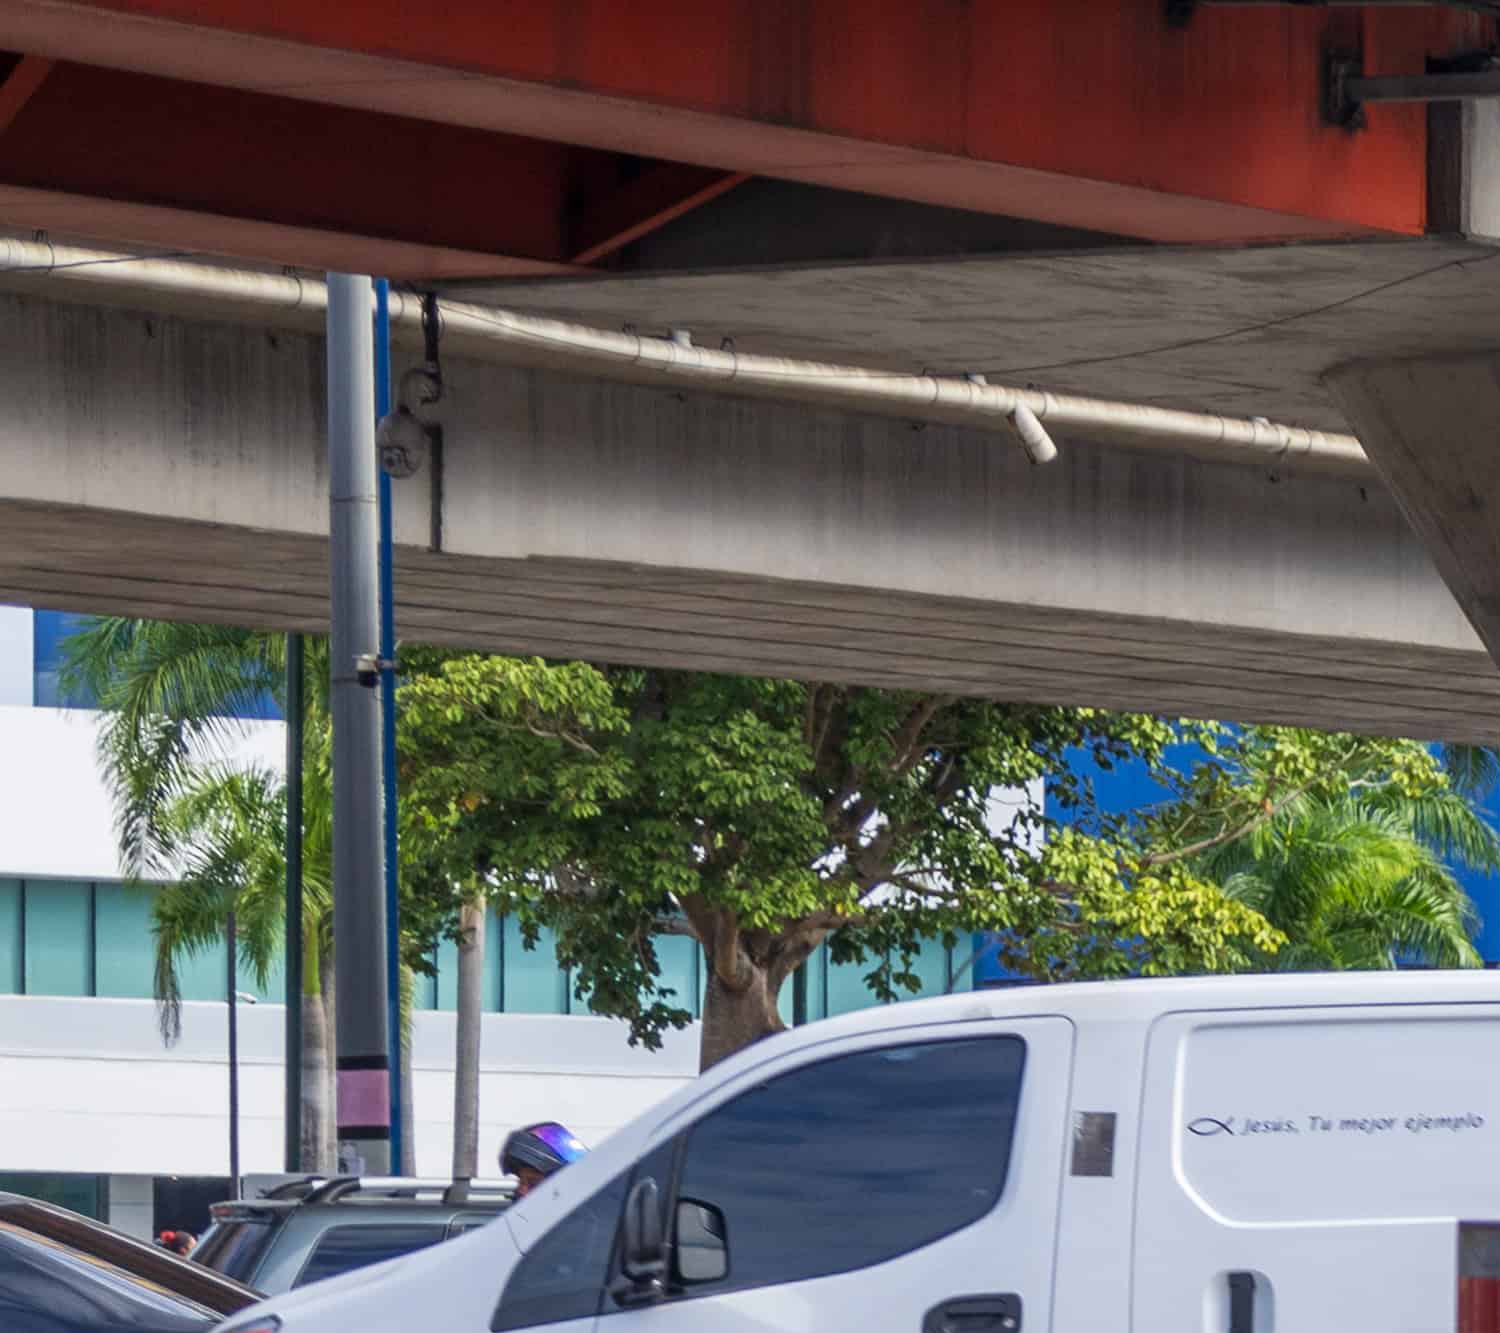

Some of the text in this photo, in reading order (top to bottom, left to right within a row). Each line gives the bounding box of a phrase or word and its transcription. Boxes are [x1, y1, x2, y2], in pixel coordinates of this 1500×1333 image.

[1308, 1114, 1332, 1132] Tu
[1339, 1115, 1397, 1134] mejor
[1404, 1111, 1484, 1133] ejemplo
